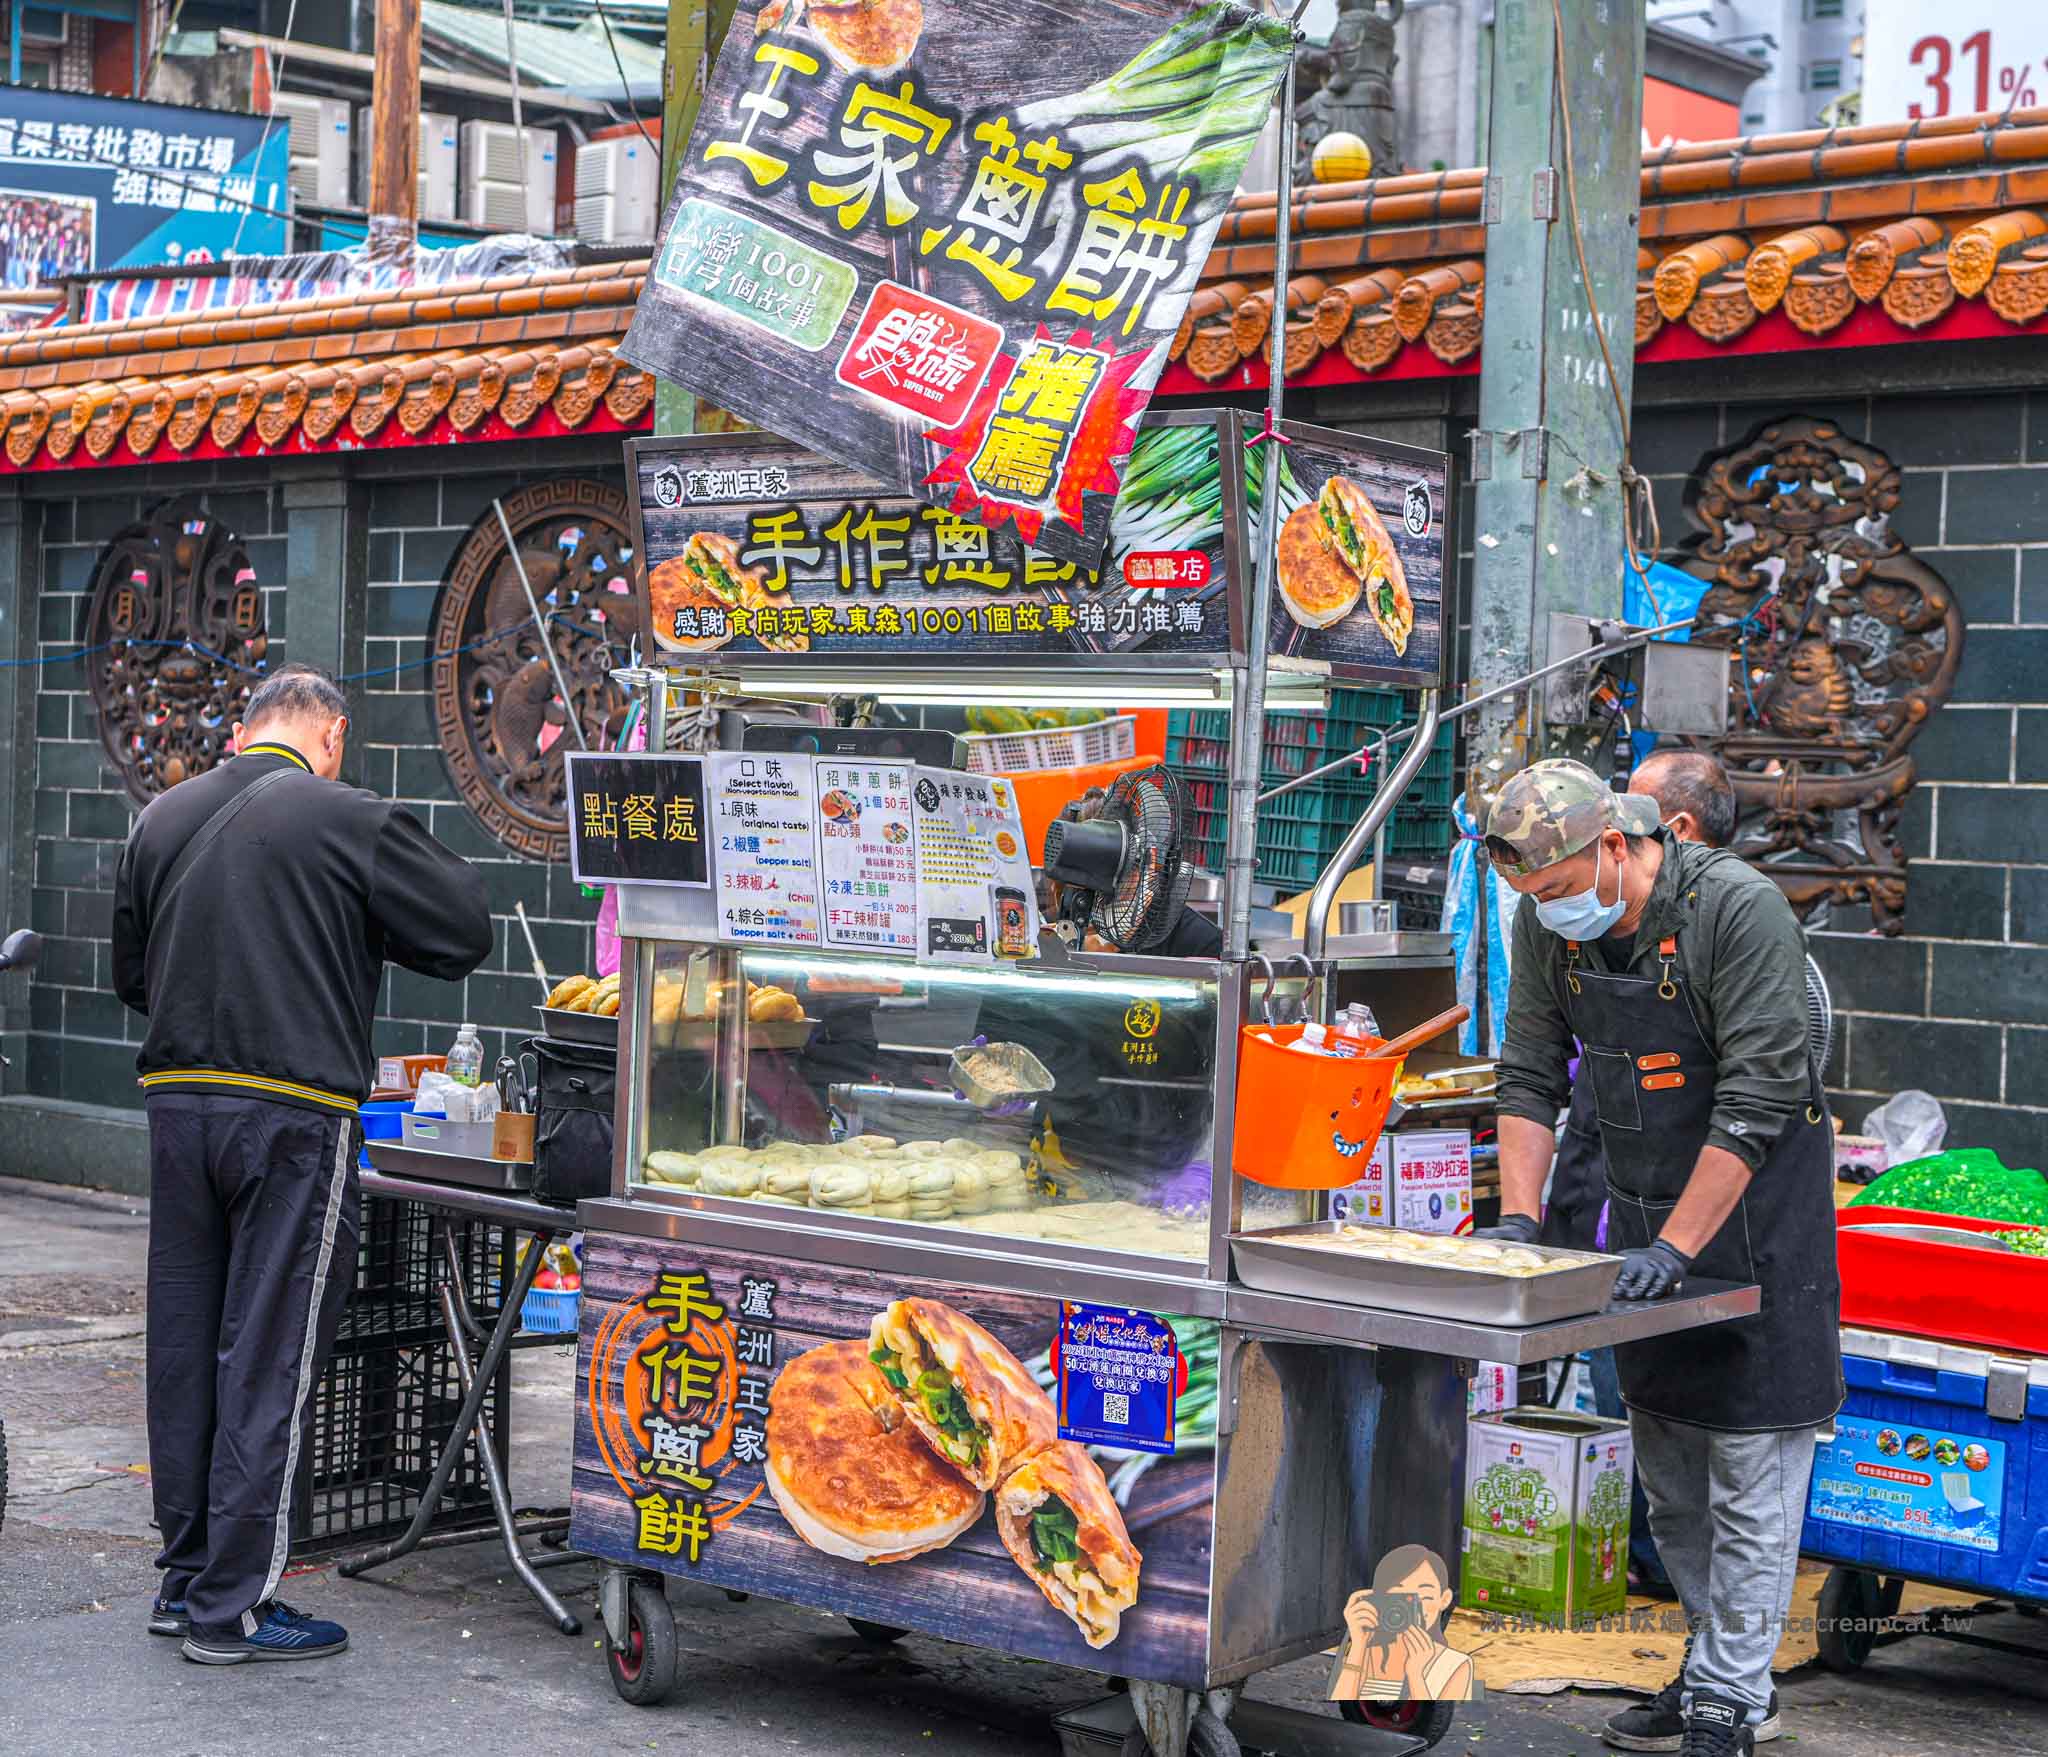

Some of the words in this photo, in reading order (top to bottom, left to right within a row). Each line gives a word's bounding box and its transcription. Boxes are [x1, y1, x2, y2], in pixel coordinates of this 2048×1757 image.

[745, 242, 824, 297] 1001
[728, 272, 816, 330] 個故事
[974, 346, 1097, 497] 推薦
[688, 469, 788, 498] 蘆洲王家
[741, 759, 782, 779] 口味
[583, 791, 699, 843] 點餐處
[823, 822, 861, 839] 點心類
[732, 1278, 774, 1464] 蘆洲王家
[634, 1271, 724, 1562] 手作蔥餅
